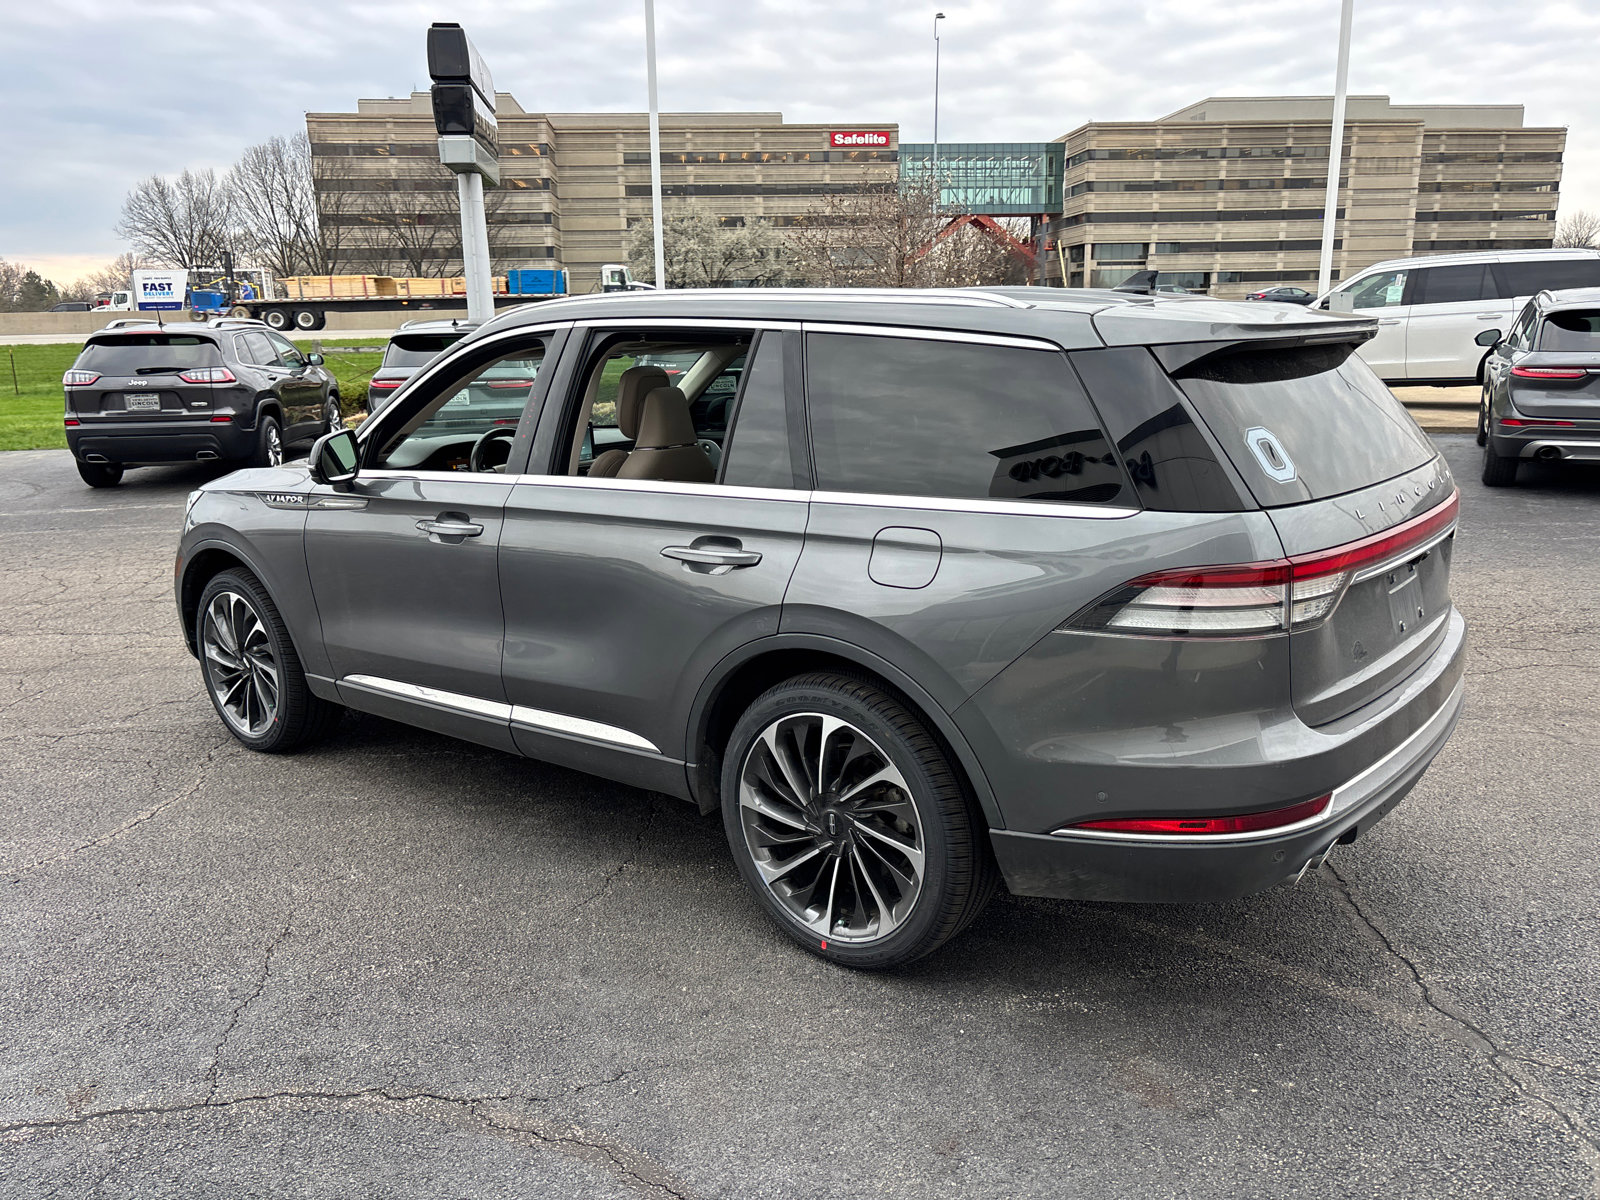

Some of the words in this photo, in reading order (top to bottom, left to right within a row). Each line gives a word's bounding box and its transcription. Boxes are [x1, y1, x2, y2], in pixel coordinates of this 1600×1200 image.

[834, 133, 887, 145] Safelite
[142, 282, 173, 292] FAST
[128, 379, 148, 387] Jeep
[265, 494, 304, 503] AVIATOR
[1355, 470, 1451, 520] LINCOLN
